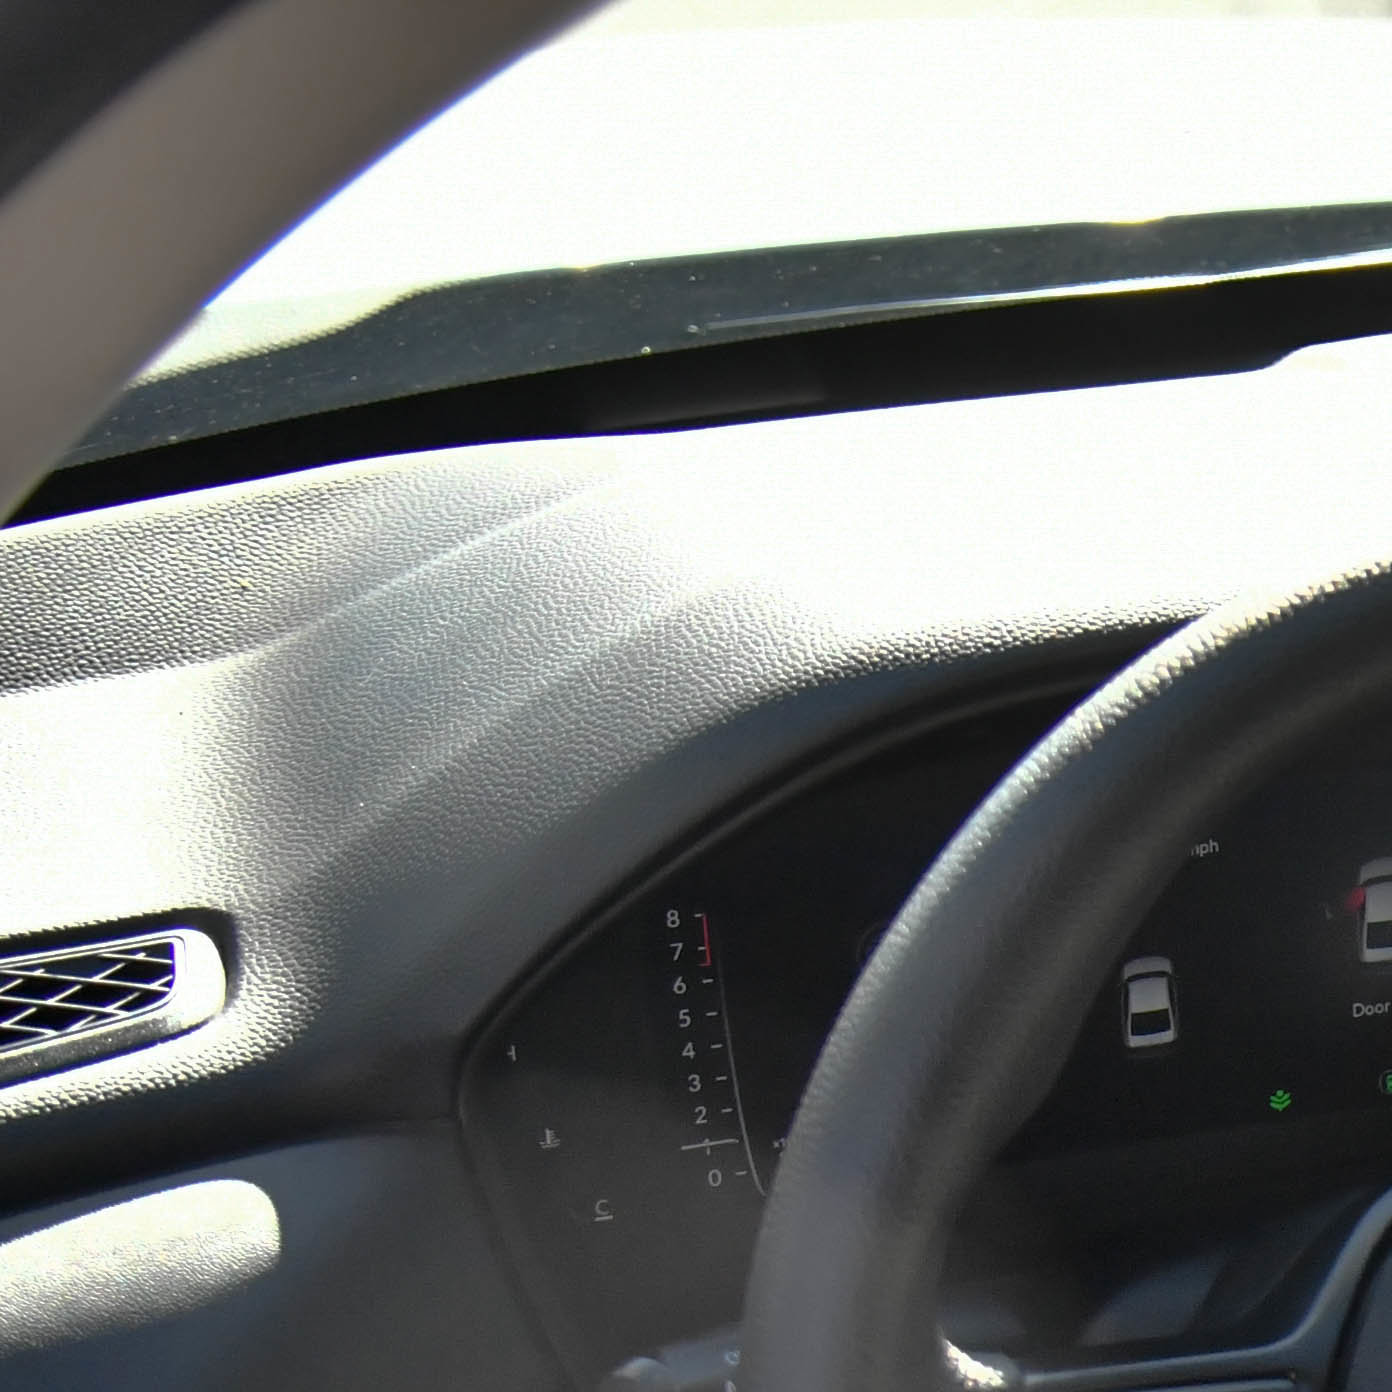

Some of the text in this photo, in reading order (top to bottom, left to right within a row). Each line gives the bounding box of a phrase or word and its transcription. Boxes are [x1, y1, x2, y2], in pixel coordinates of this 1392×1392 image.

[666, 909, 681, 929] 8
[669, 942, 684, 961] 7
[672, 976, 688, 995] 6
[678, 1009, 692, 1028] 5
[1351, 1000, 1391, 1018] Door
[682, 1041, 696, 1060] 4
[688, 1074, 702, 1093] 3
[694, 1106, 708, 1125] 2
[707, 1169, 722, 1187] 0
